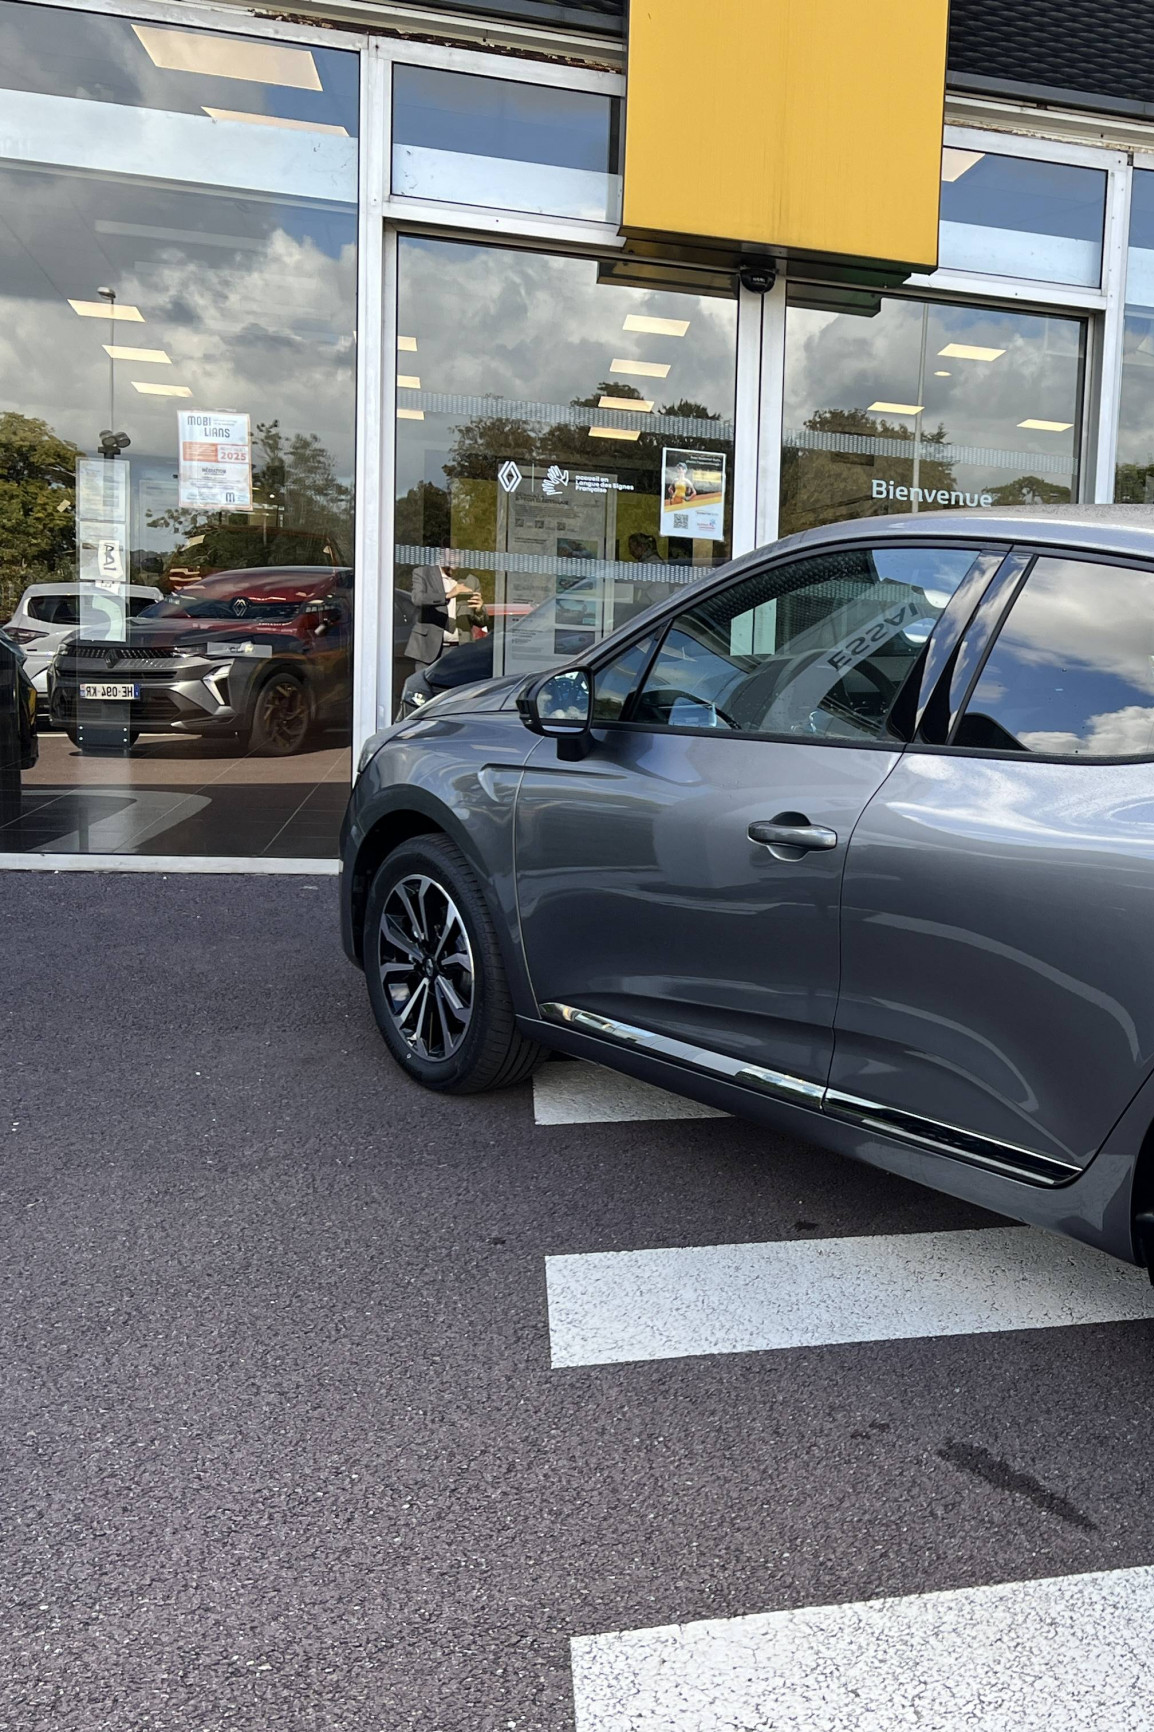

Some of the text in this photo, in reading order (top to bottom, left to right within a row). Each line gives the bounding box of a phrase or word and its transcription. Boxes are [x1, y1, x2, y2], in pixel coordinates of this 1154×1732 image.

[187, 415, 212, 427] MOBI
[204, 427, 231, 438] LIANS
[220, 451, 247, 461] 2025
[575, 480, 600, 488] Langue
[871, 479, 993, 508] Bienvenue
